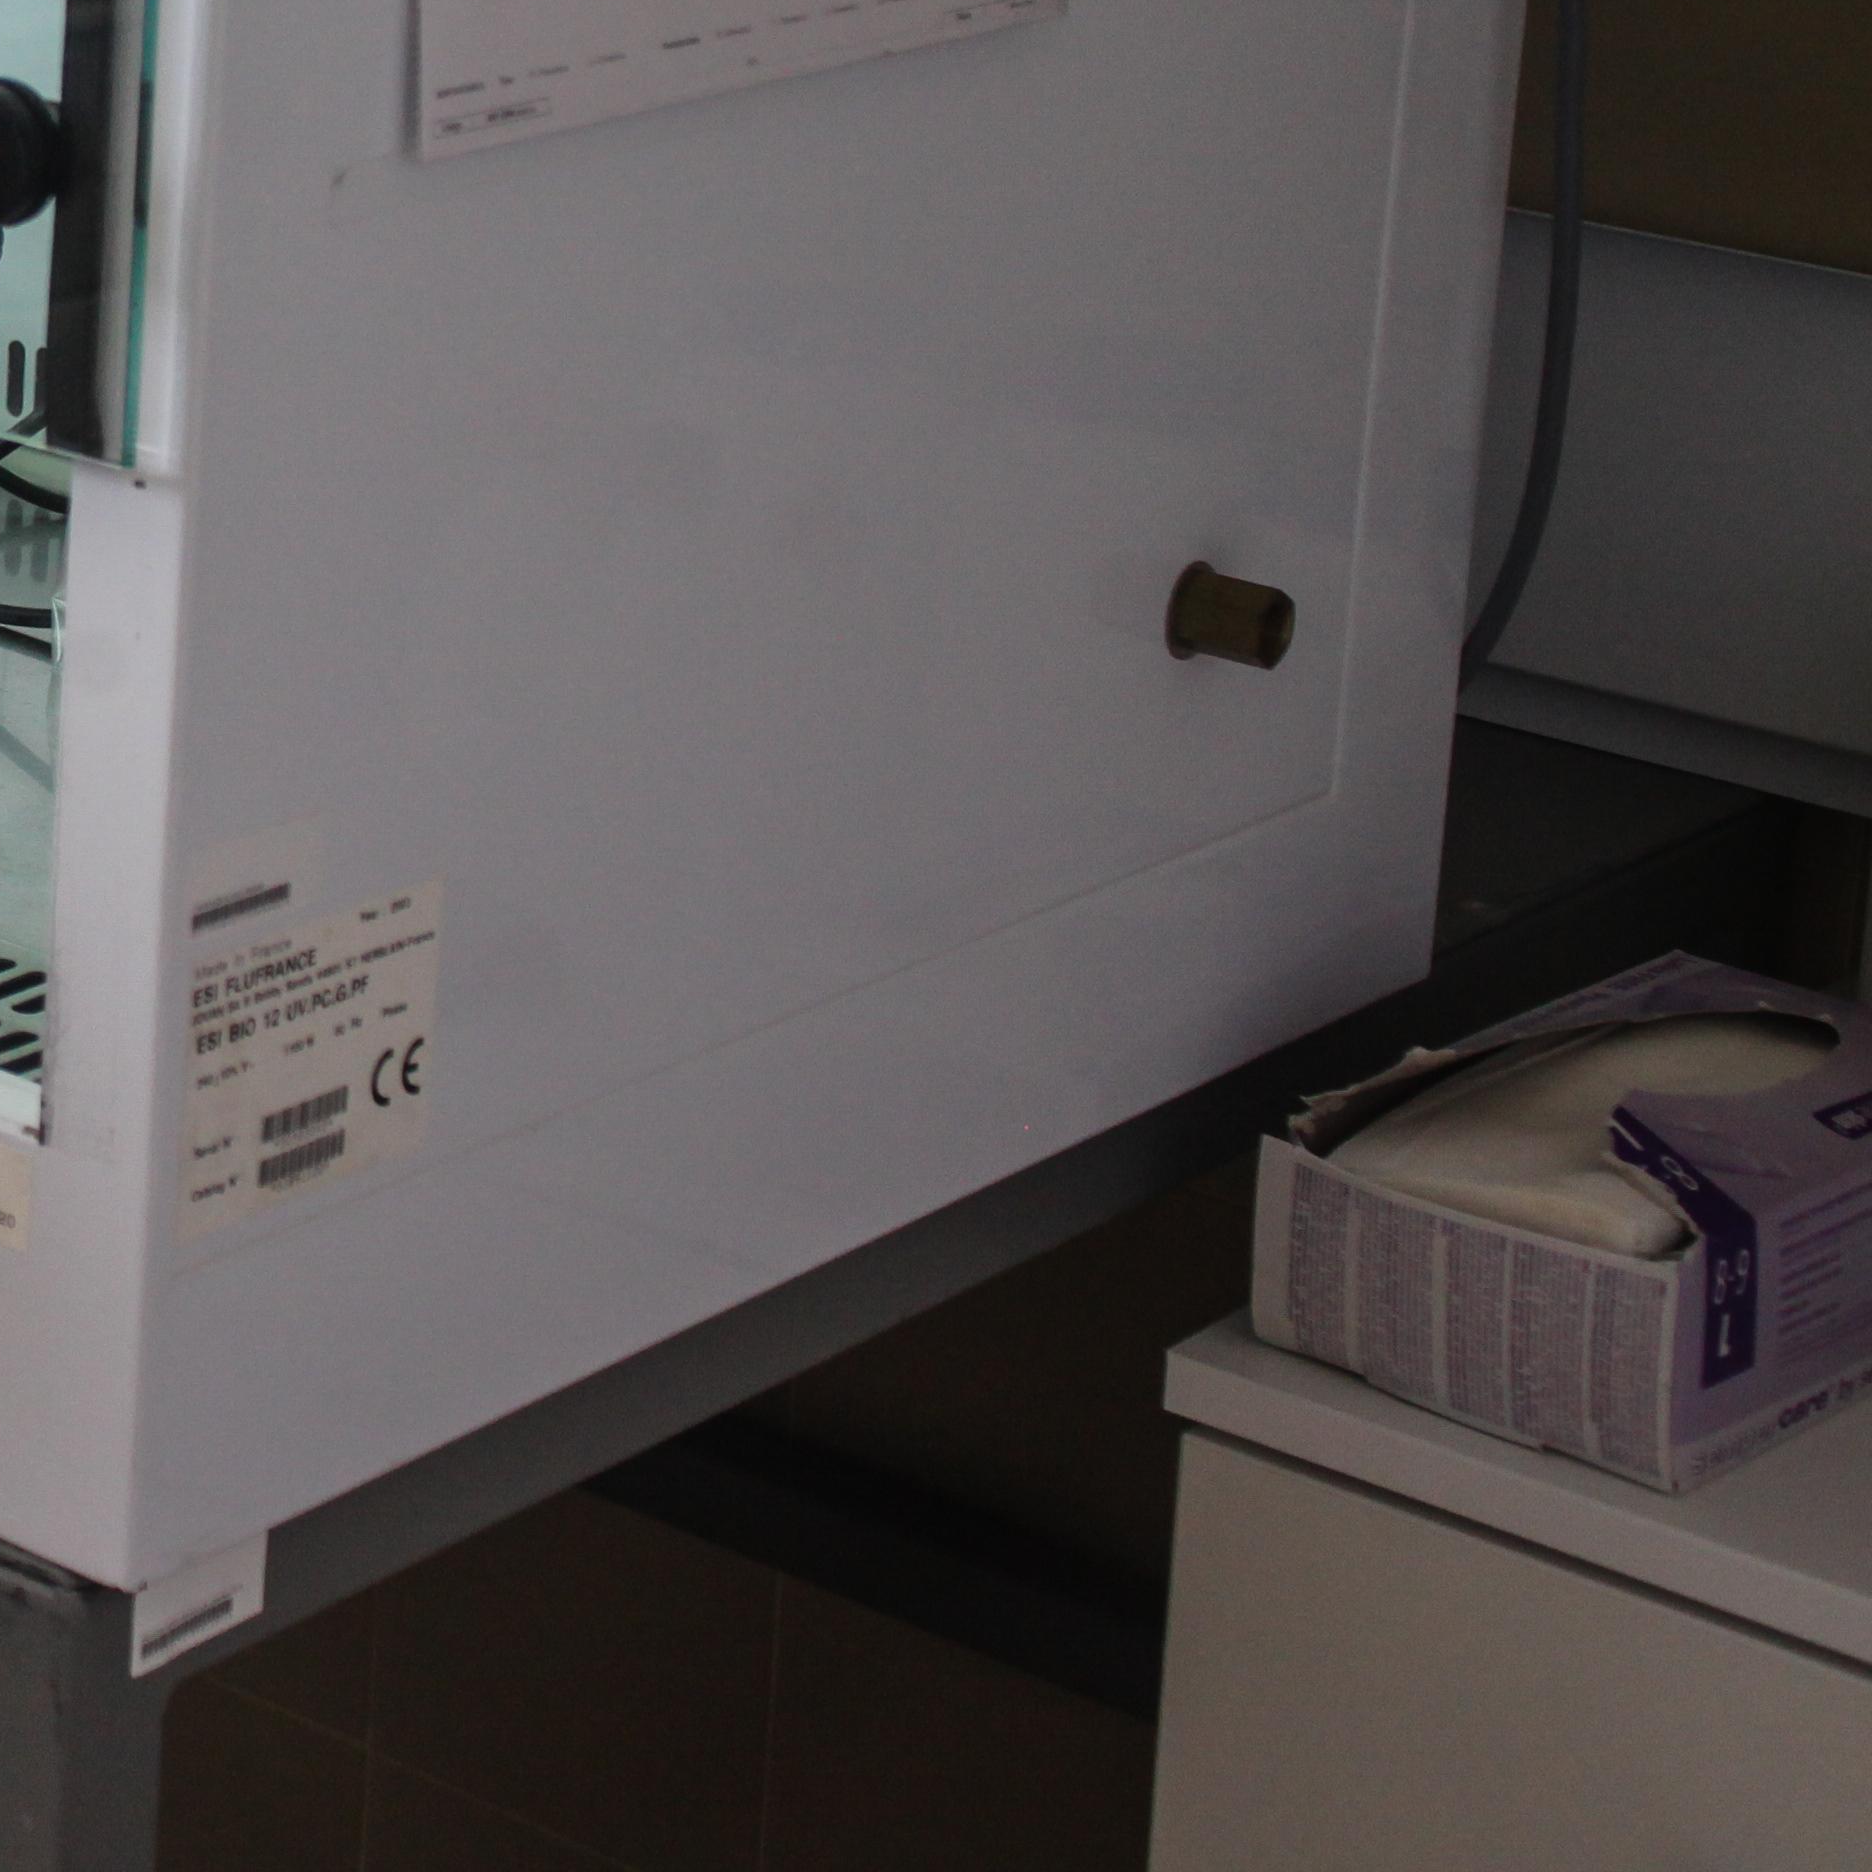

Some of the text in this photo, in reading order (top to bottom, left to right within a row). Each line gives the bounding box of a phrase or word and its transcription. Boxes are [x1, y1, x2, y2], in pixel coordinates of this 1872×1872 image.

[193, 984, 218, 1009] ESI
[224, 947, 318, 995] FLUFRANCE
[196, 1030, 222, 1056] ESI
[229, 1017, 257, 1044] BIO
[264, 1008, 281, 1030] 12
